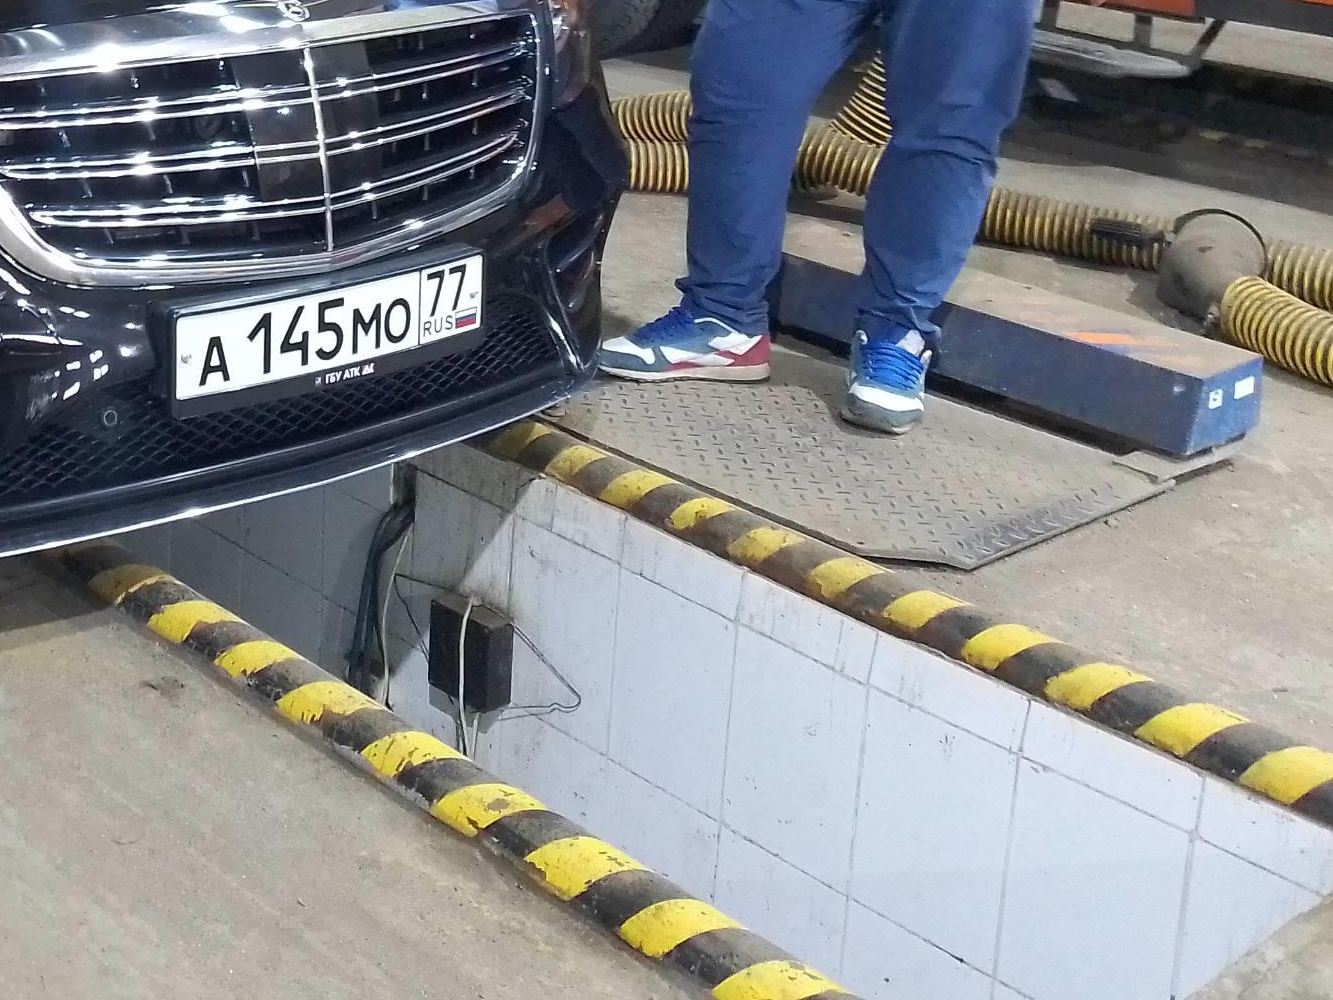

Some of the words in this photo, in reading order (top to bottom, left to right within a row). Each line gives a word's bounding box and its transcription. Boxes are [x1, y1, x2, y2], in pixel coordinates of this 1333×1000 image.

[426, 263, 467, 317] 77
[423, 314, 454, 337] RUS
[325, 370, 343, 385] ГБУ
[342, 365, 361, 381] АТК
